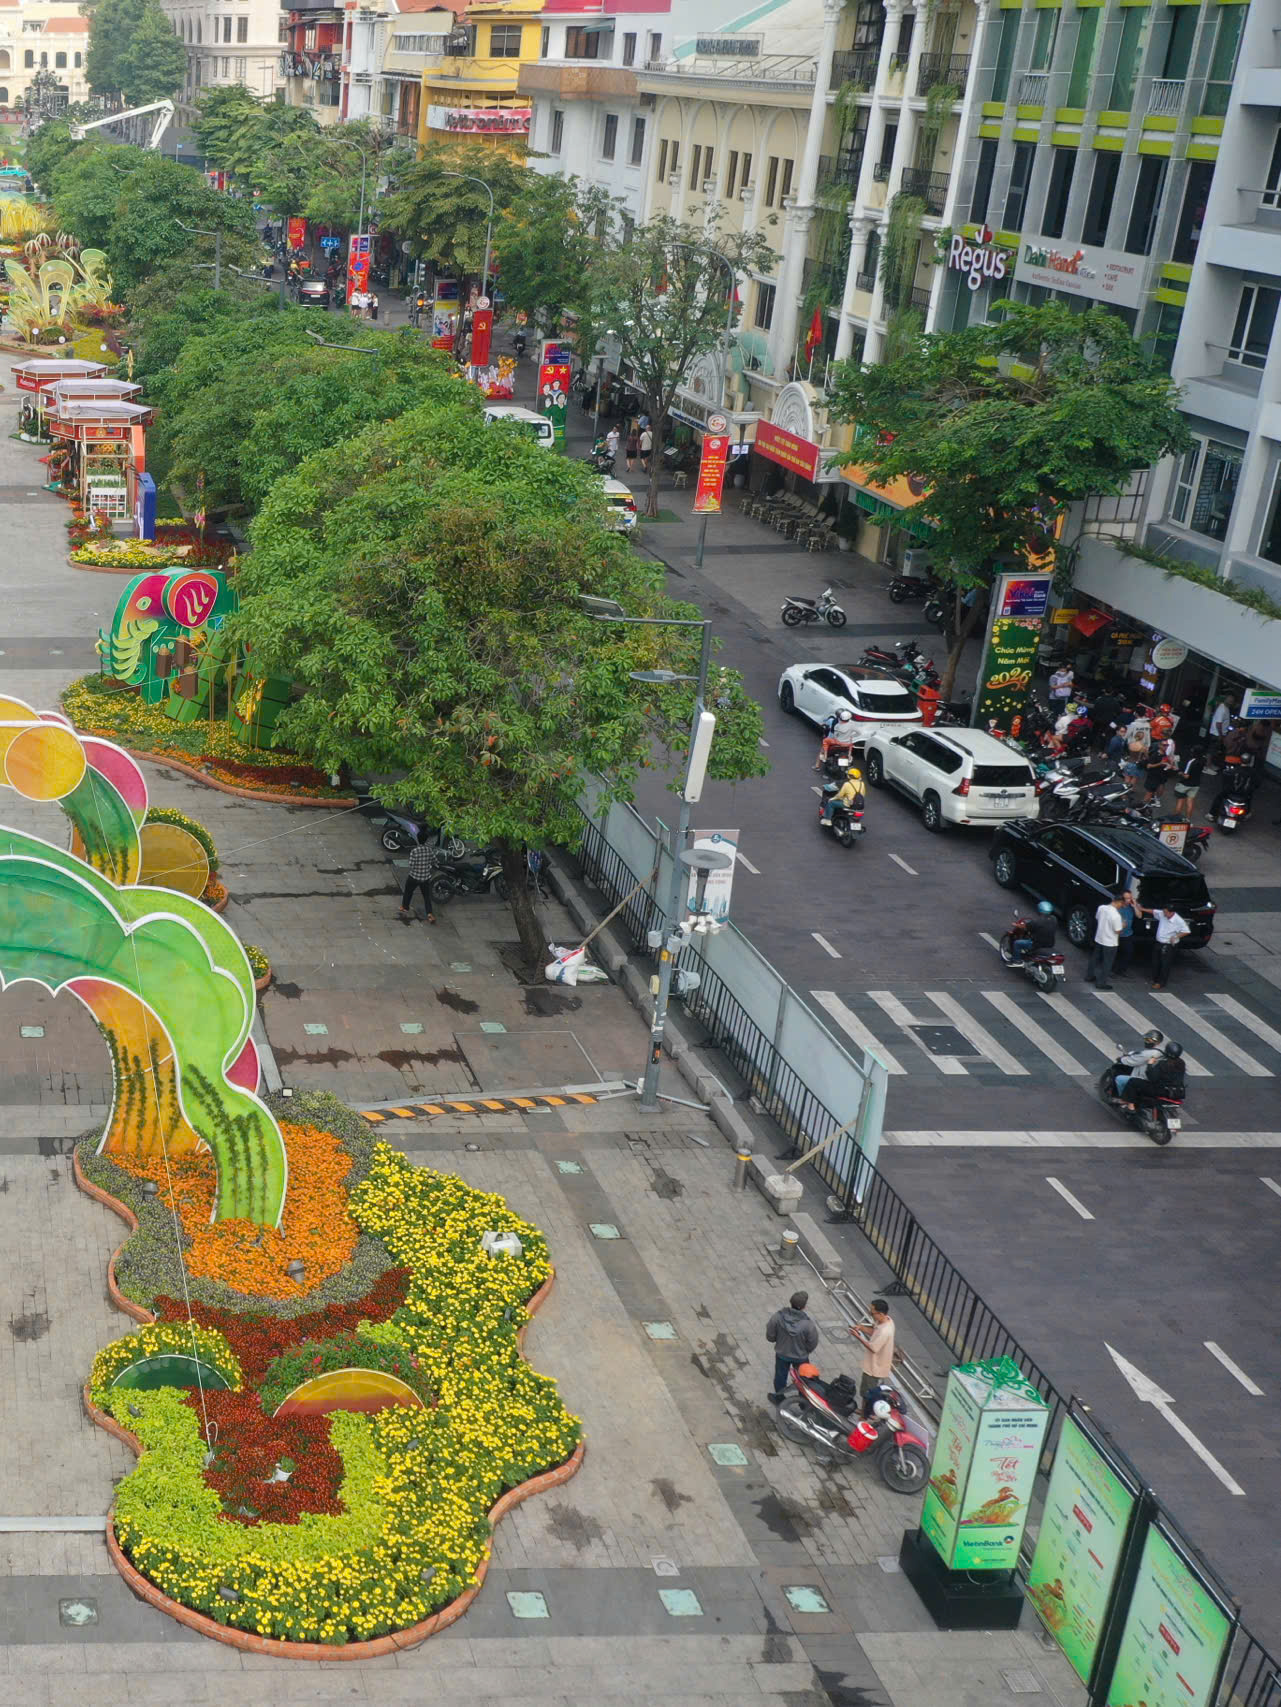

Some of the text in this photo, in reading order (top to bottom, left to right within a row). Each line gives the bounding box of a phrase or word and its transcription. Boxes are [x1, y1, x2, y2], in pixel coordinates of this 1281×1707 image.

[948, 234, 1007, 291] Regus
[1016, 646, 1035, 654] Mừng
[997, 657, 1016, 665] Năm
[990, 667, 1032, 685] 2026
[963, 1540, 1004, 1548] VietinBank
